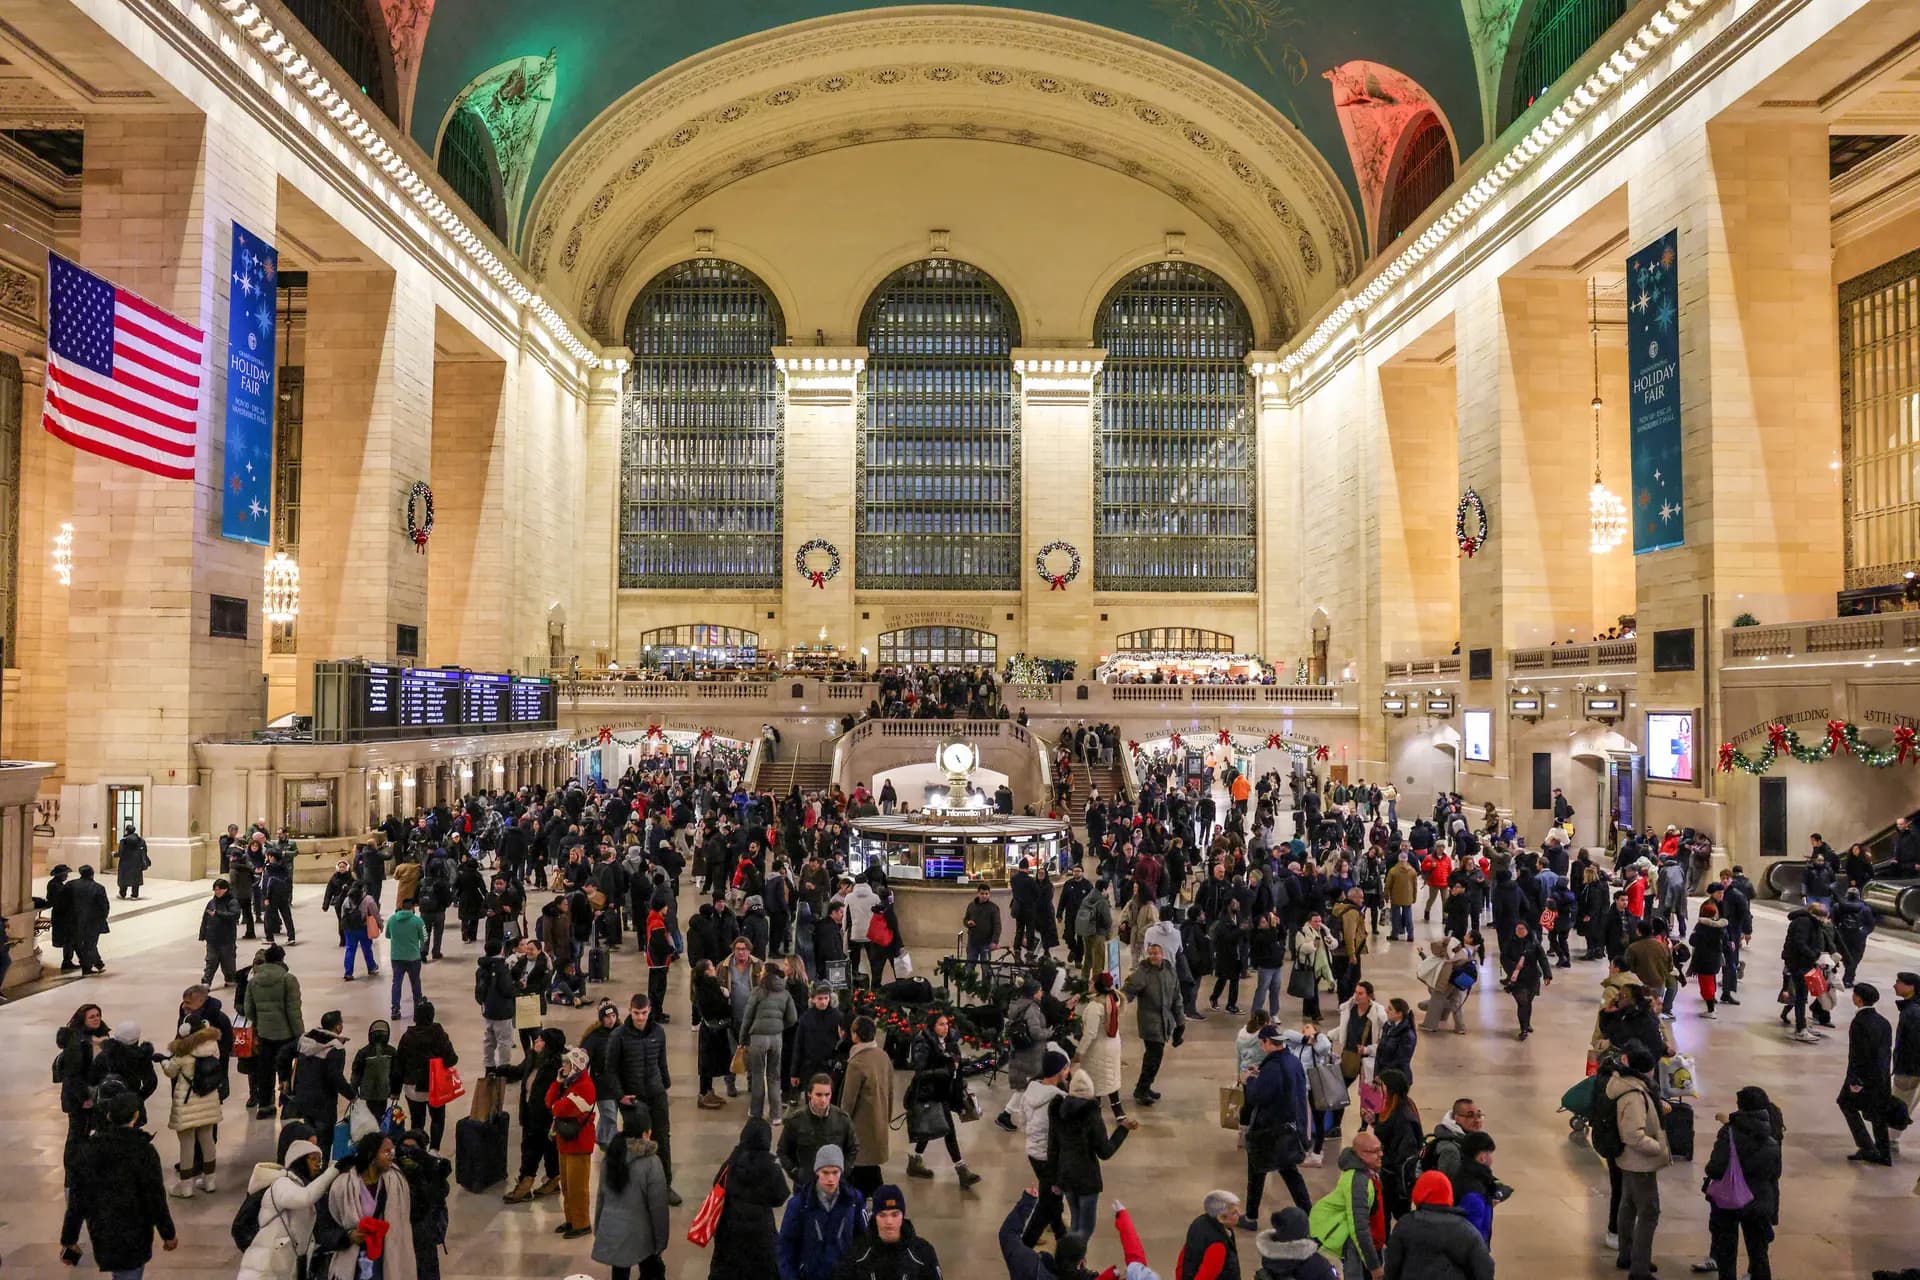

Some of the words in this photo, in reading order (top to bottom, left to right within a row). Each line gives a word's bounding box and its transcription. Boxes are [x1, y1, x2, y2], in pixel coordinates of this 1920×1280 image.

[231, 354, 271, 384] HOLIDAY
[1633, 362, 1676, 394] HOLIDAY
[241, 376, 265, 396] FAIR
[1644, 384, 1664, 405] FAIR
[956, 612, 985, 622] AVENUE
[886, 622, 900, 630] THE
[947, 618, 990, 630] APARTMENT
[1864, 710, 1892, 724] 45TH
[668, 722, 698, 730] SUBWAY
[1237, 725, 1266, 733] TRACKS
[1732, 730, 1749, 746] THE
[1784, 708, 1829, 725] BUILDING
[1144, 728, 1170, 739] TICKET
[946, 808, 980, 816] Information
